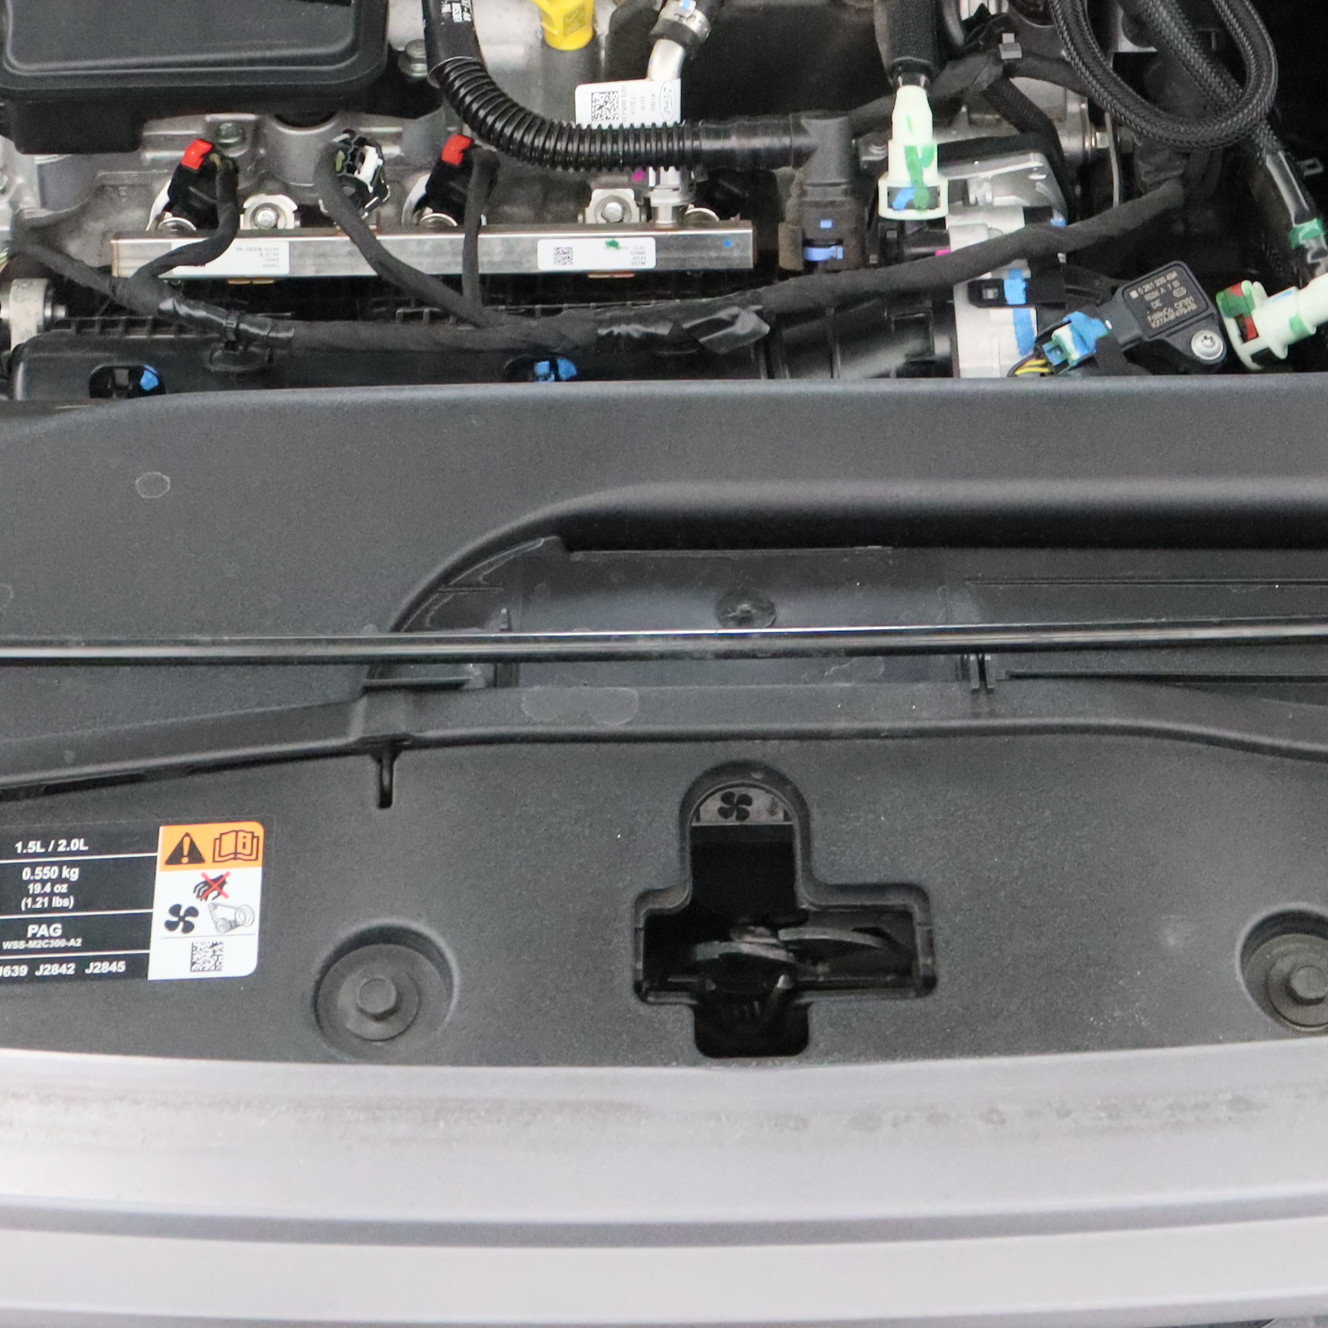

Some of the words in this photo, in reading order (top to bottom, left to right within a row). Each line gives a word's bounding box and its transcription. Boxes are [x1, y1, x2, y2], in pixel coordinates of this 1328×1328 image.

[14, 841, 45, 853] 1.5L
[57, 838, 89, 852] 2.0L
[22, 866, 59, 880] 0.550
[61, 866, 80, 881] kg
[28, 883, 52, 894] 19.4
[54, 883, 69, 893] oz
[21, 897, 49, 911] (1.21
[52, 895, 74, 909] lbs)
[27, 923, 63, 938] PAG
[35, 962, 76, 976] J2842
[84, 960, 126, 974] J2845
